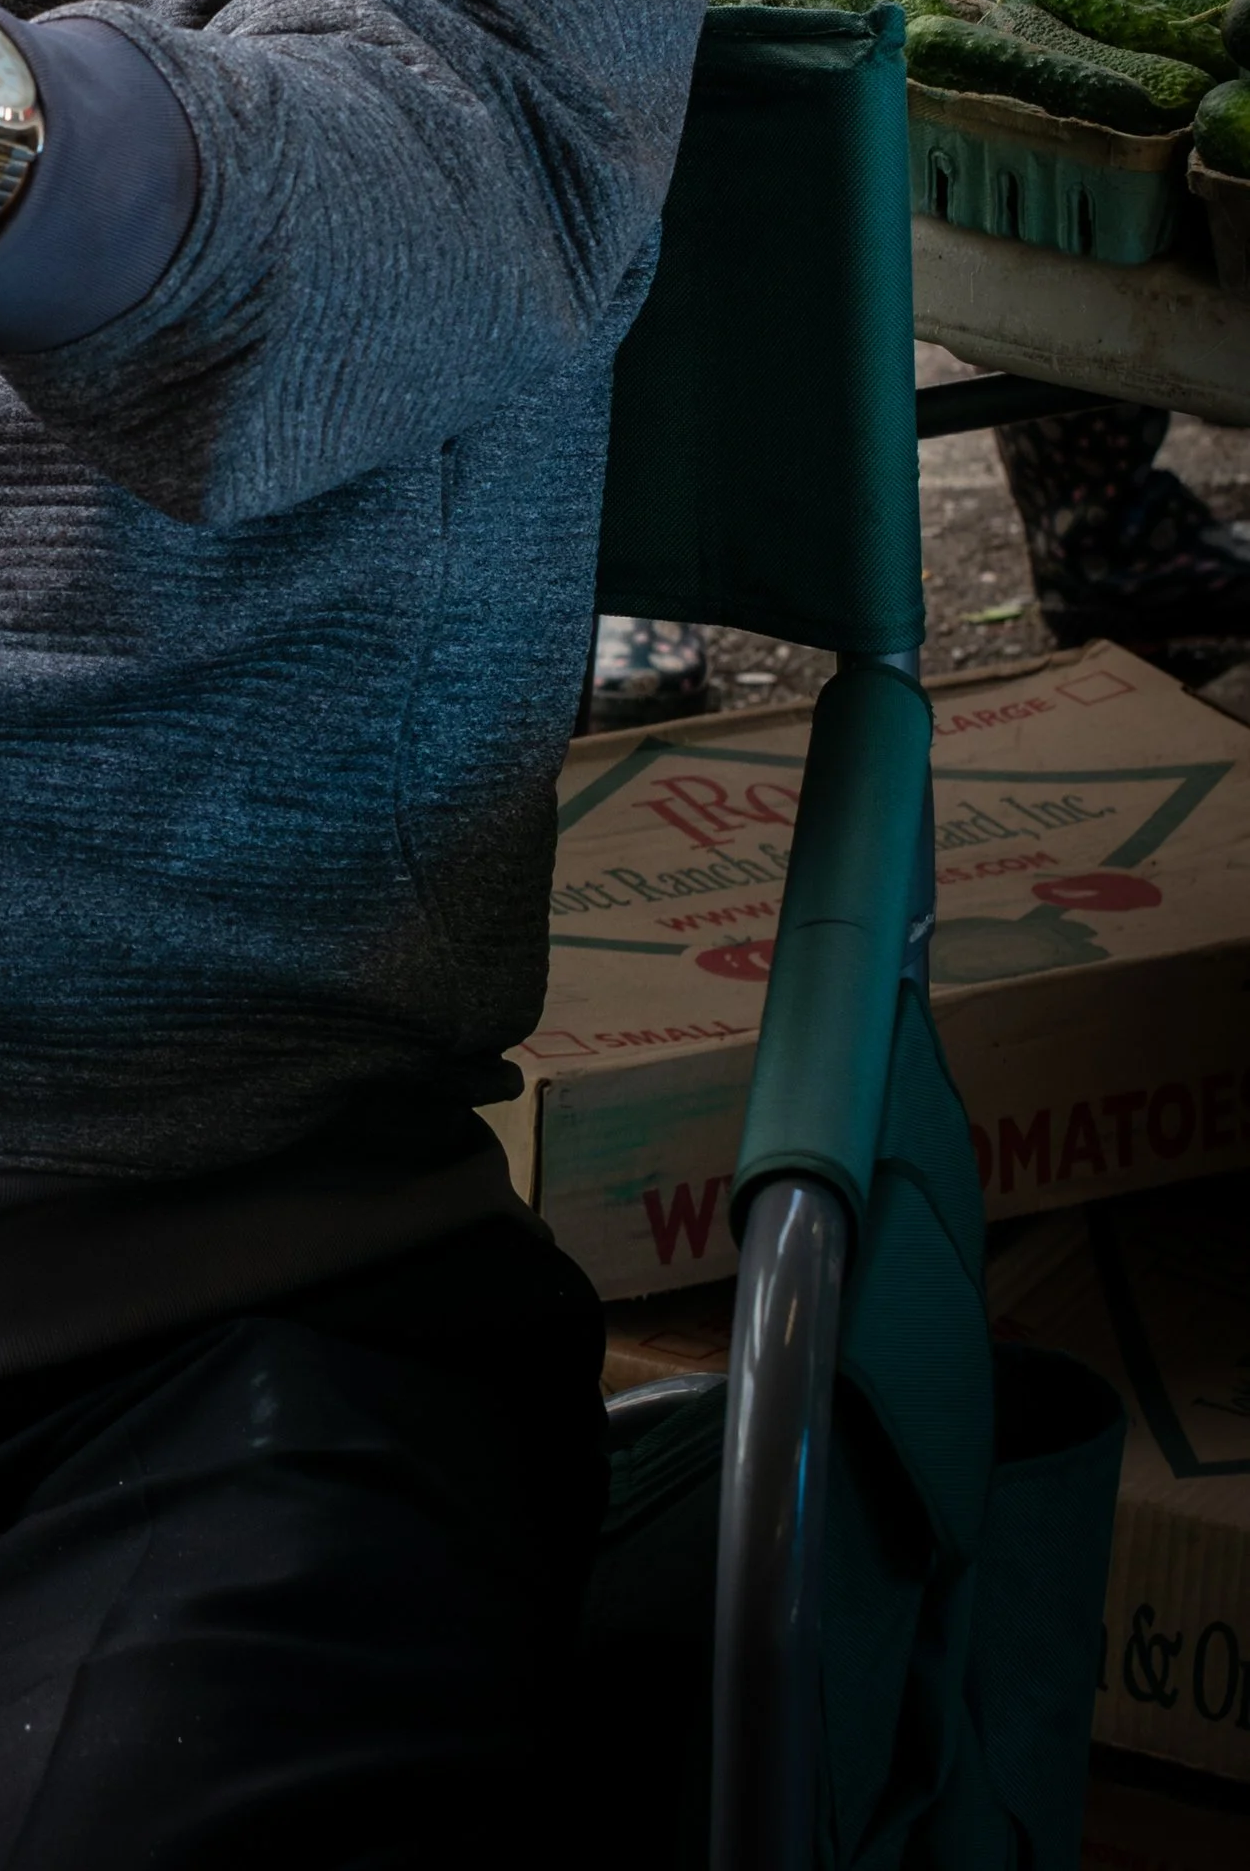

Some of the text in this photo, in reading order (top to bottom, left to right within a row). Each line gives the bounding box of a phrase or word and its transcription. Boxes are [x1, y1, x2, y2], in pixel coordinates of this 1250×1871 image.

[603, 845, 786, 904] Ranch
[1000, 794, 1117, 830] Inc.
[1124, 1602, 1183, 1710] &
